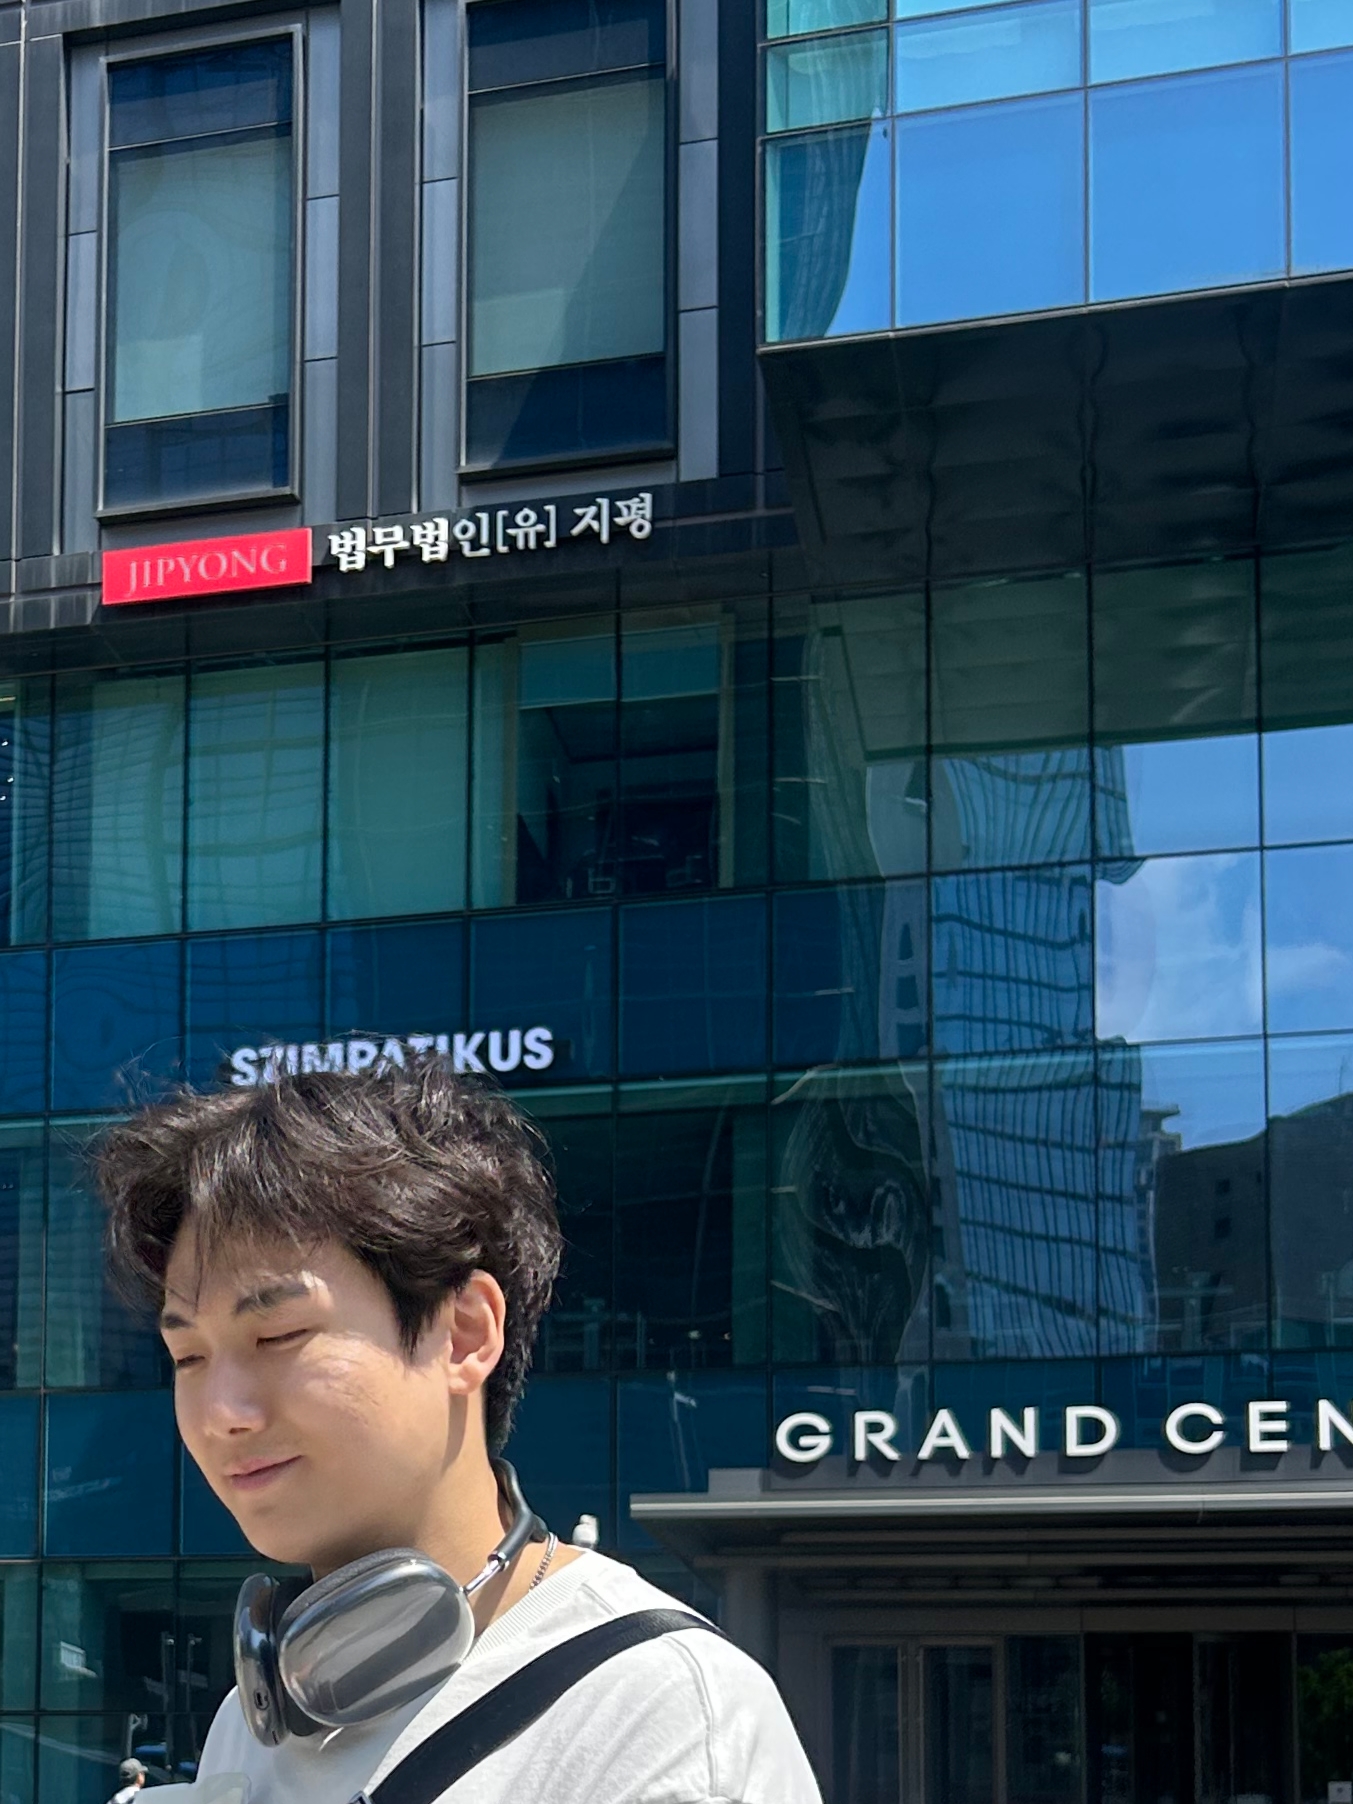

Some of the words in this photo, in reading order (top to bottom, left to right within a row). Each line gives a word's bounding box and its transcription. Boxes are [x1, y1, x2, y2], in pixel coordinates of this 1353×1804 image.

[329, 504, 557, 573] 법무법인[유]
[570, 492, 653, 543] 지평
[127, 543, 288, 596] JIPYONG
[775, 1404, 1119, 1463] GRAND
